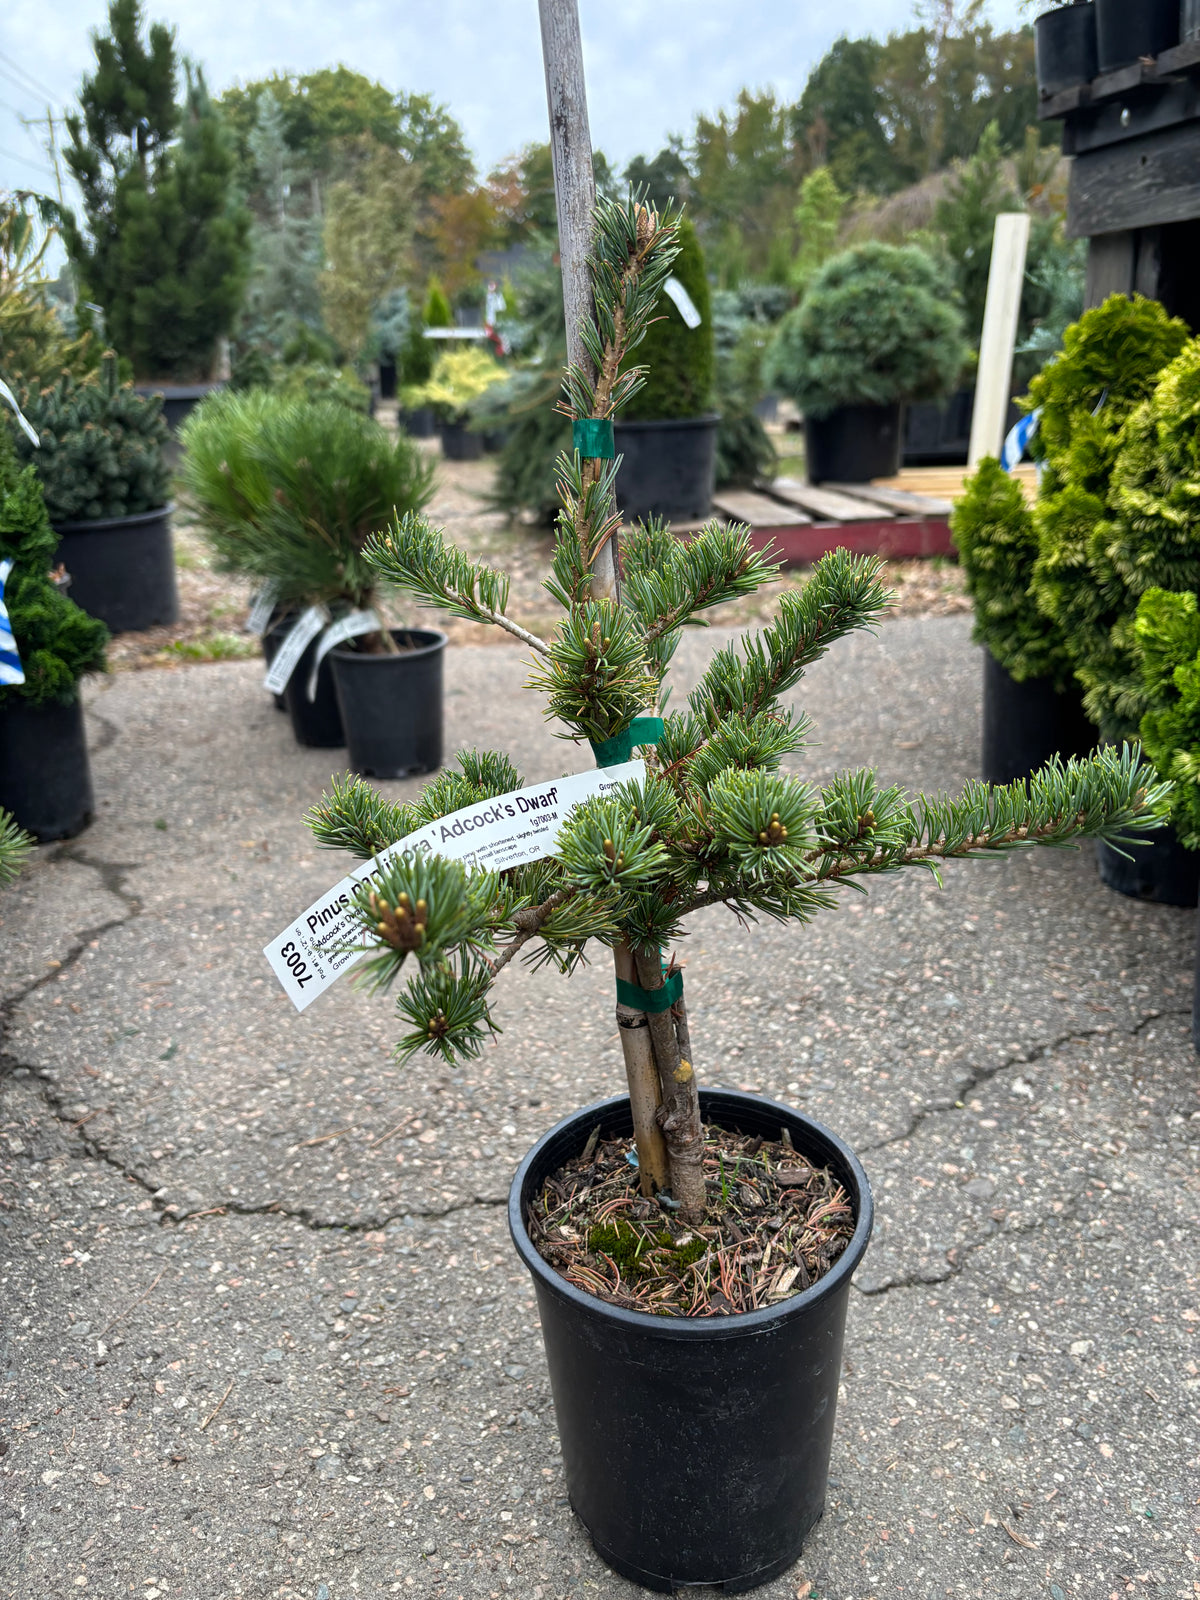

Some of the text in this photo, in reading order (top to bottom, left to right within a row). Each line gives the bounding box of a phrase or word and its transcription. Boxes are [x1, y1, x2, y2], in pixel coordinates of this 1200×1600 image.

[529, 812, 559, 827] 1g7003-M
[306, 893, 350, 935] Pinus
[431, 803, 515, 843] 'Adcock's
[515, 787, 558, 813] Dwarf'
[333, 845, 541, 970] Grown Silverton, OR
[281, 941, 313, 989] 7003
[317, 967, 326, 980] Pot
